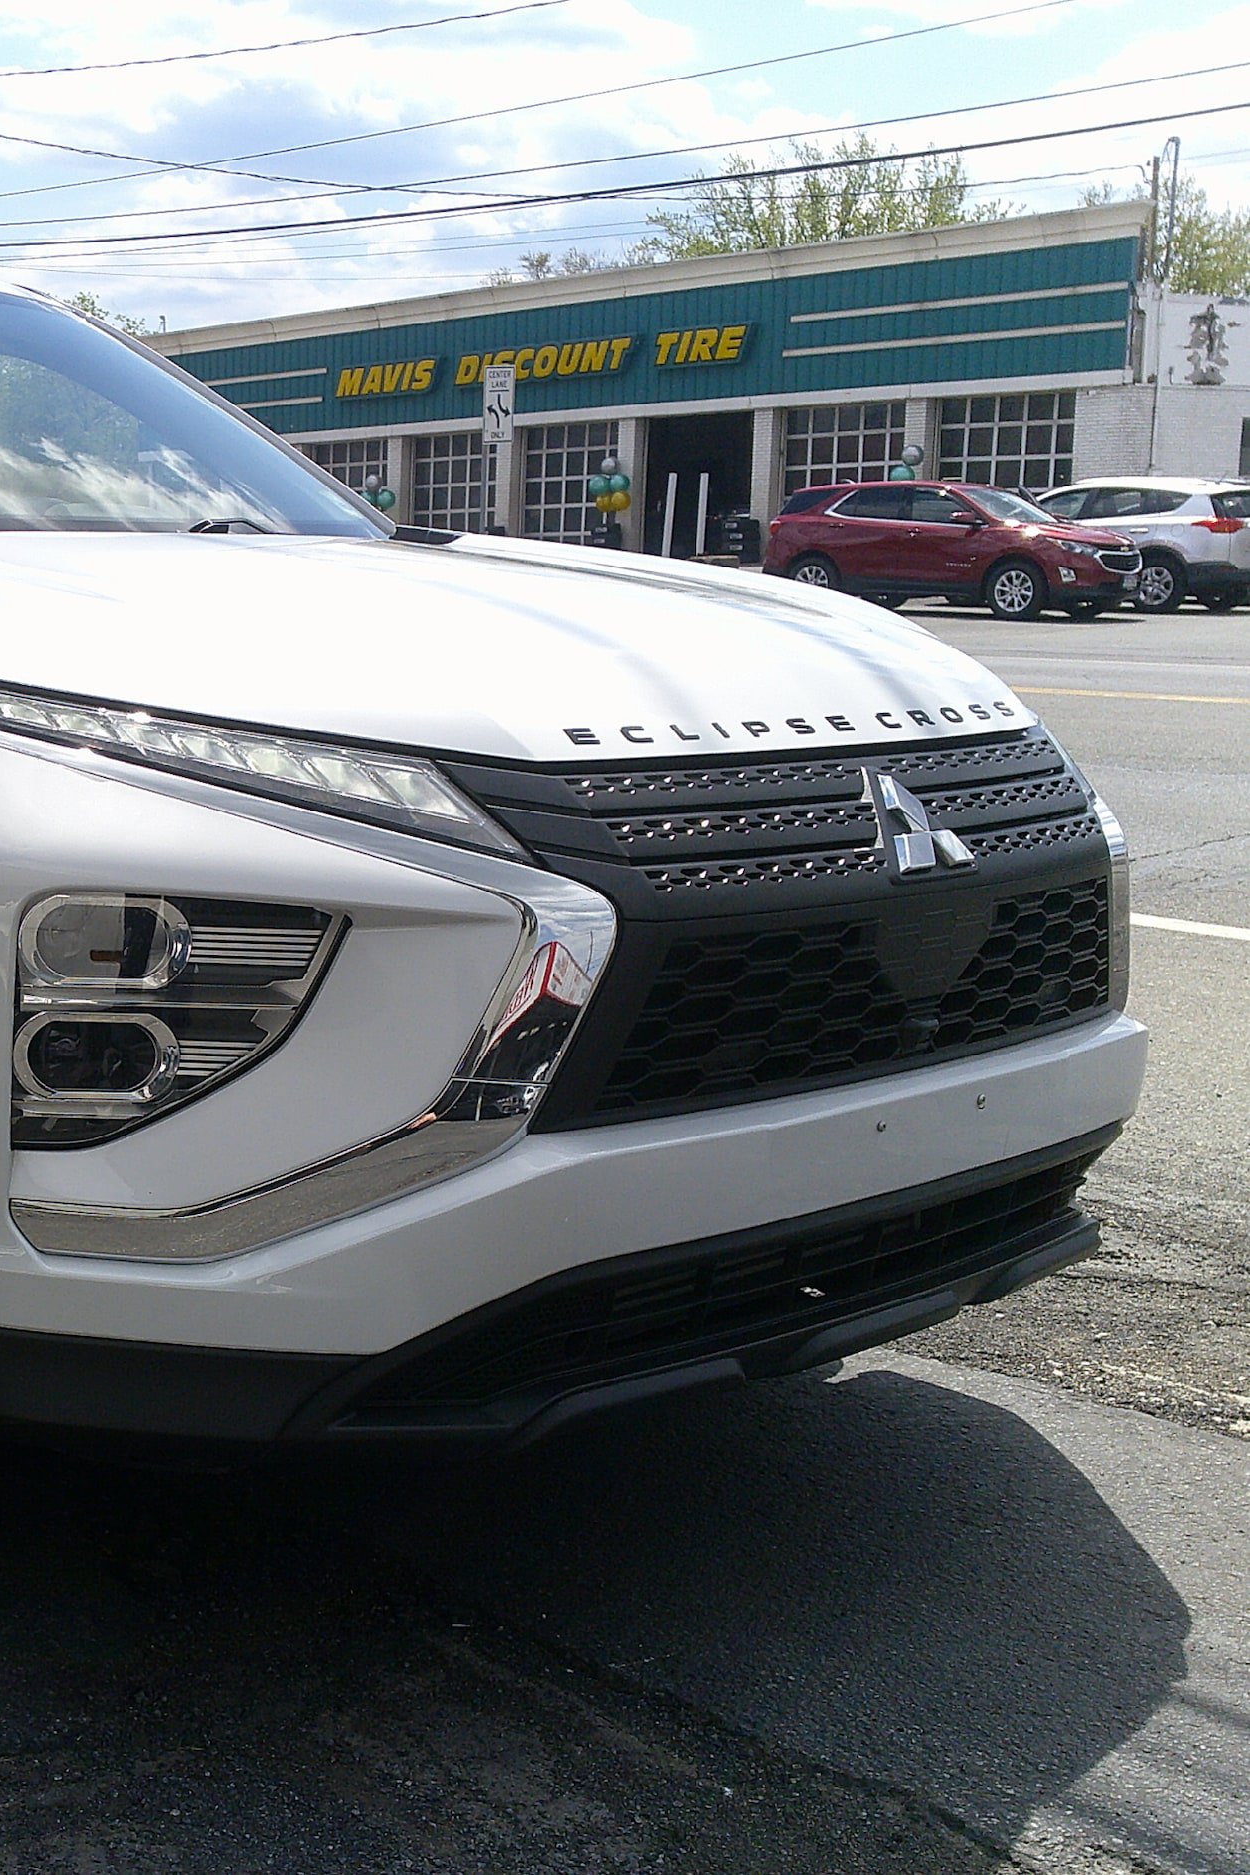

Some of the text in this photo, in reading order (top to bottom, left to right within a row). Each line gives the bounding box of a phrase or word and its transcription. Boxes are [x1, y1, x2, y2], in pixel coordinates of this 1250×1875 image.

[336, 359, 436, 398] MAVIS
[655, 324, 747, 365] TIRE
[489, 370, 511, 379] CENTER
[491, 380, 508, 388] LANE
[490, 431, 505, 439] ONLY
[563, 701, 1015, 746] ECLIPSE CROSS
